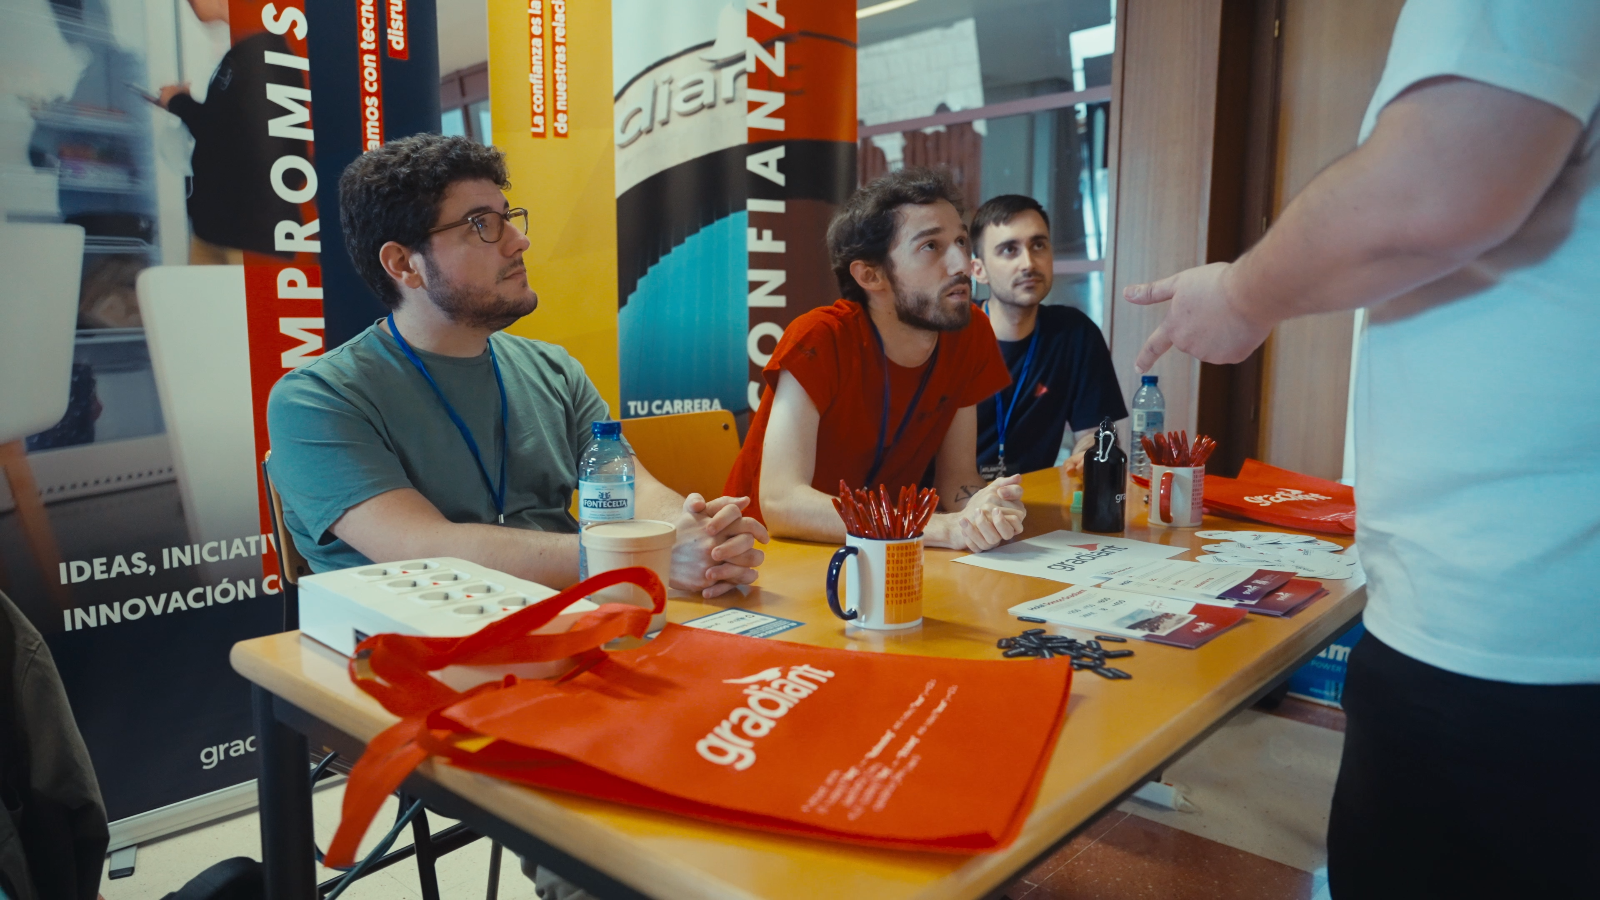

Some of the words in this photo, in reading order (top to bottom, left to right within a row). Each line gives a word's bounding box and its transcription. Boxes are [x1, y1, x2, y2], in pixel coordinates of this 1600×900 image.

[527, 0, 542, 15] la
[530, 16, 543, 36] es
[363, 54, 379, 93] con
[529, 37, 544, 113] confianza
[554, 44, 567, 111] nuestras
[364, 96, 381, 154] amos
[531, 115, 545, 133] La
[554, 112, 568, 134] de
[628, 401, 649, 416] TU
[652, 398, 722, 414] CARRERA
[584, 499, 627, 508] FONTECELTA
[59, 551, 156, 585] IDEAS,
[1047, 545, 1129, 572] gradiant
[63, 578, 256, 632] INNOVACIÓN
[262, 574, 284, 595] C
[696, 664, 835, 771] gradiant
